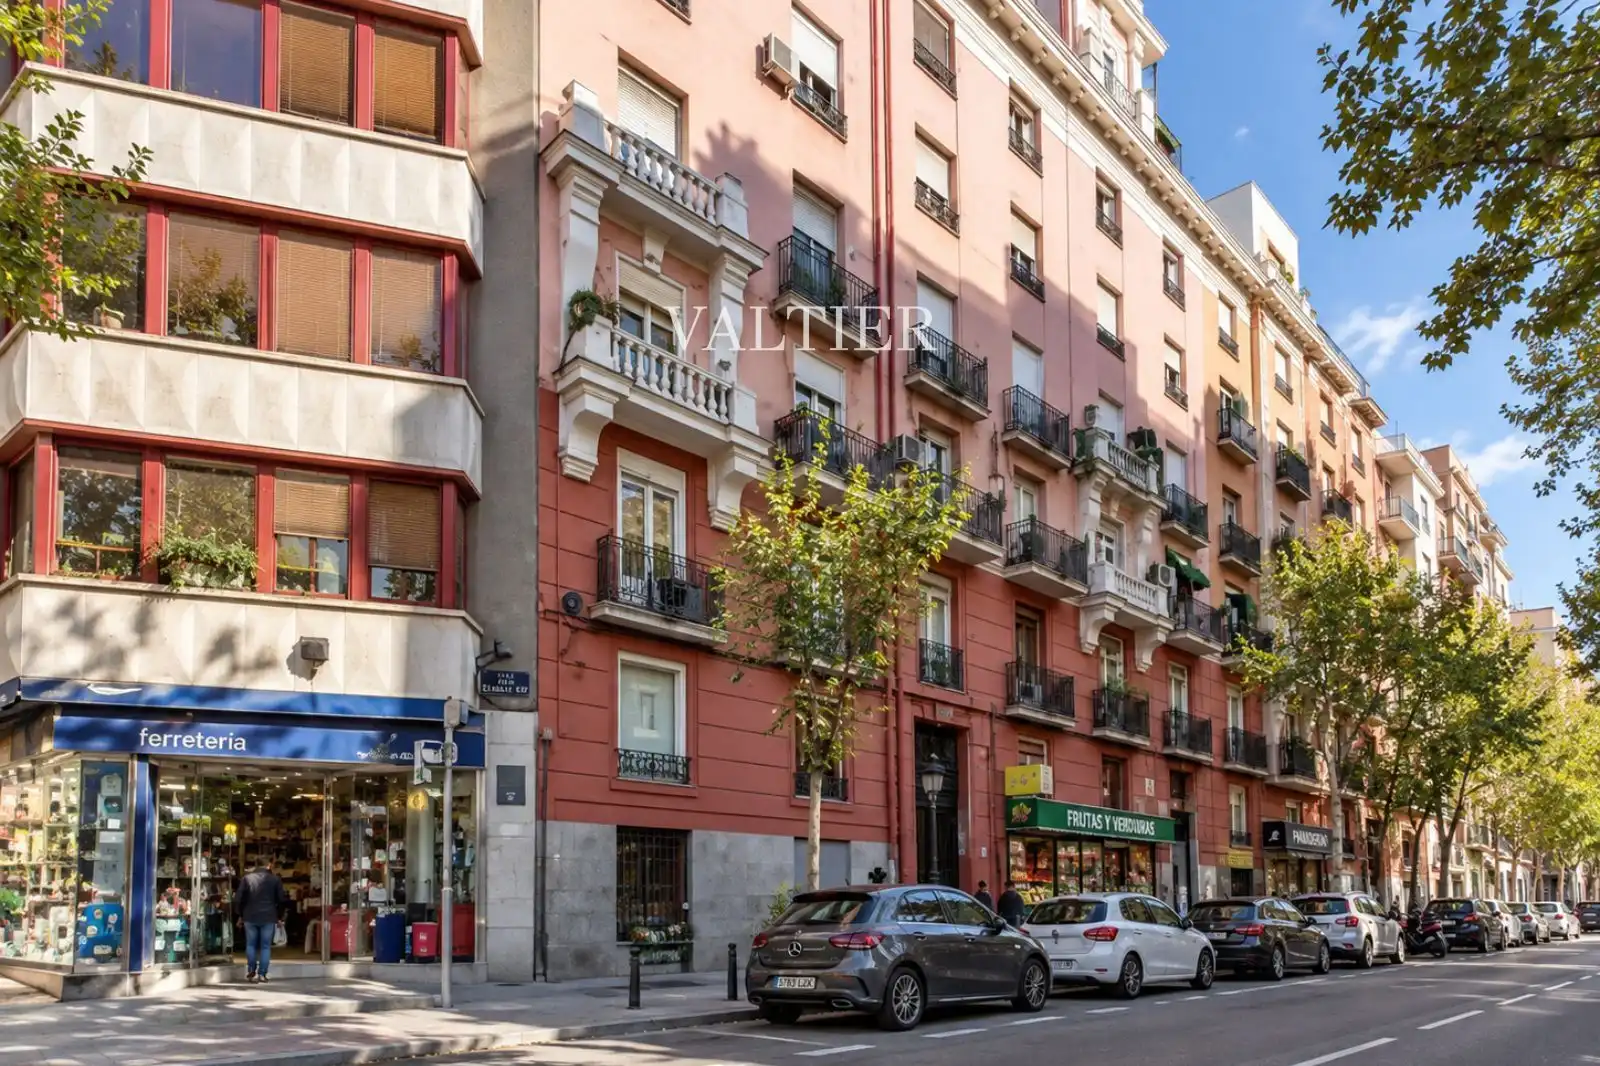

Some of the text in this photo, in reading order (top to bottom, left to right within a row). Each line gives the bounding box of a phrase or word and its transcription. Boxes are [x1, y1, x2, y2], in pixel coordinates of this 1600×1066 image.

[139, 727, 247, 751] ferreteria
[1067, 809, 1103, 829] FRUTAS
[1105, 815, 1112, 831] Y
